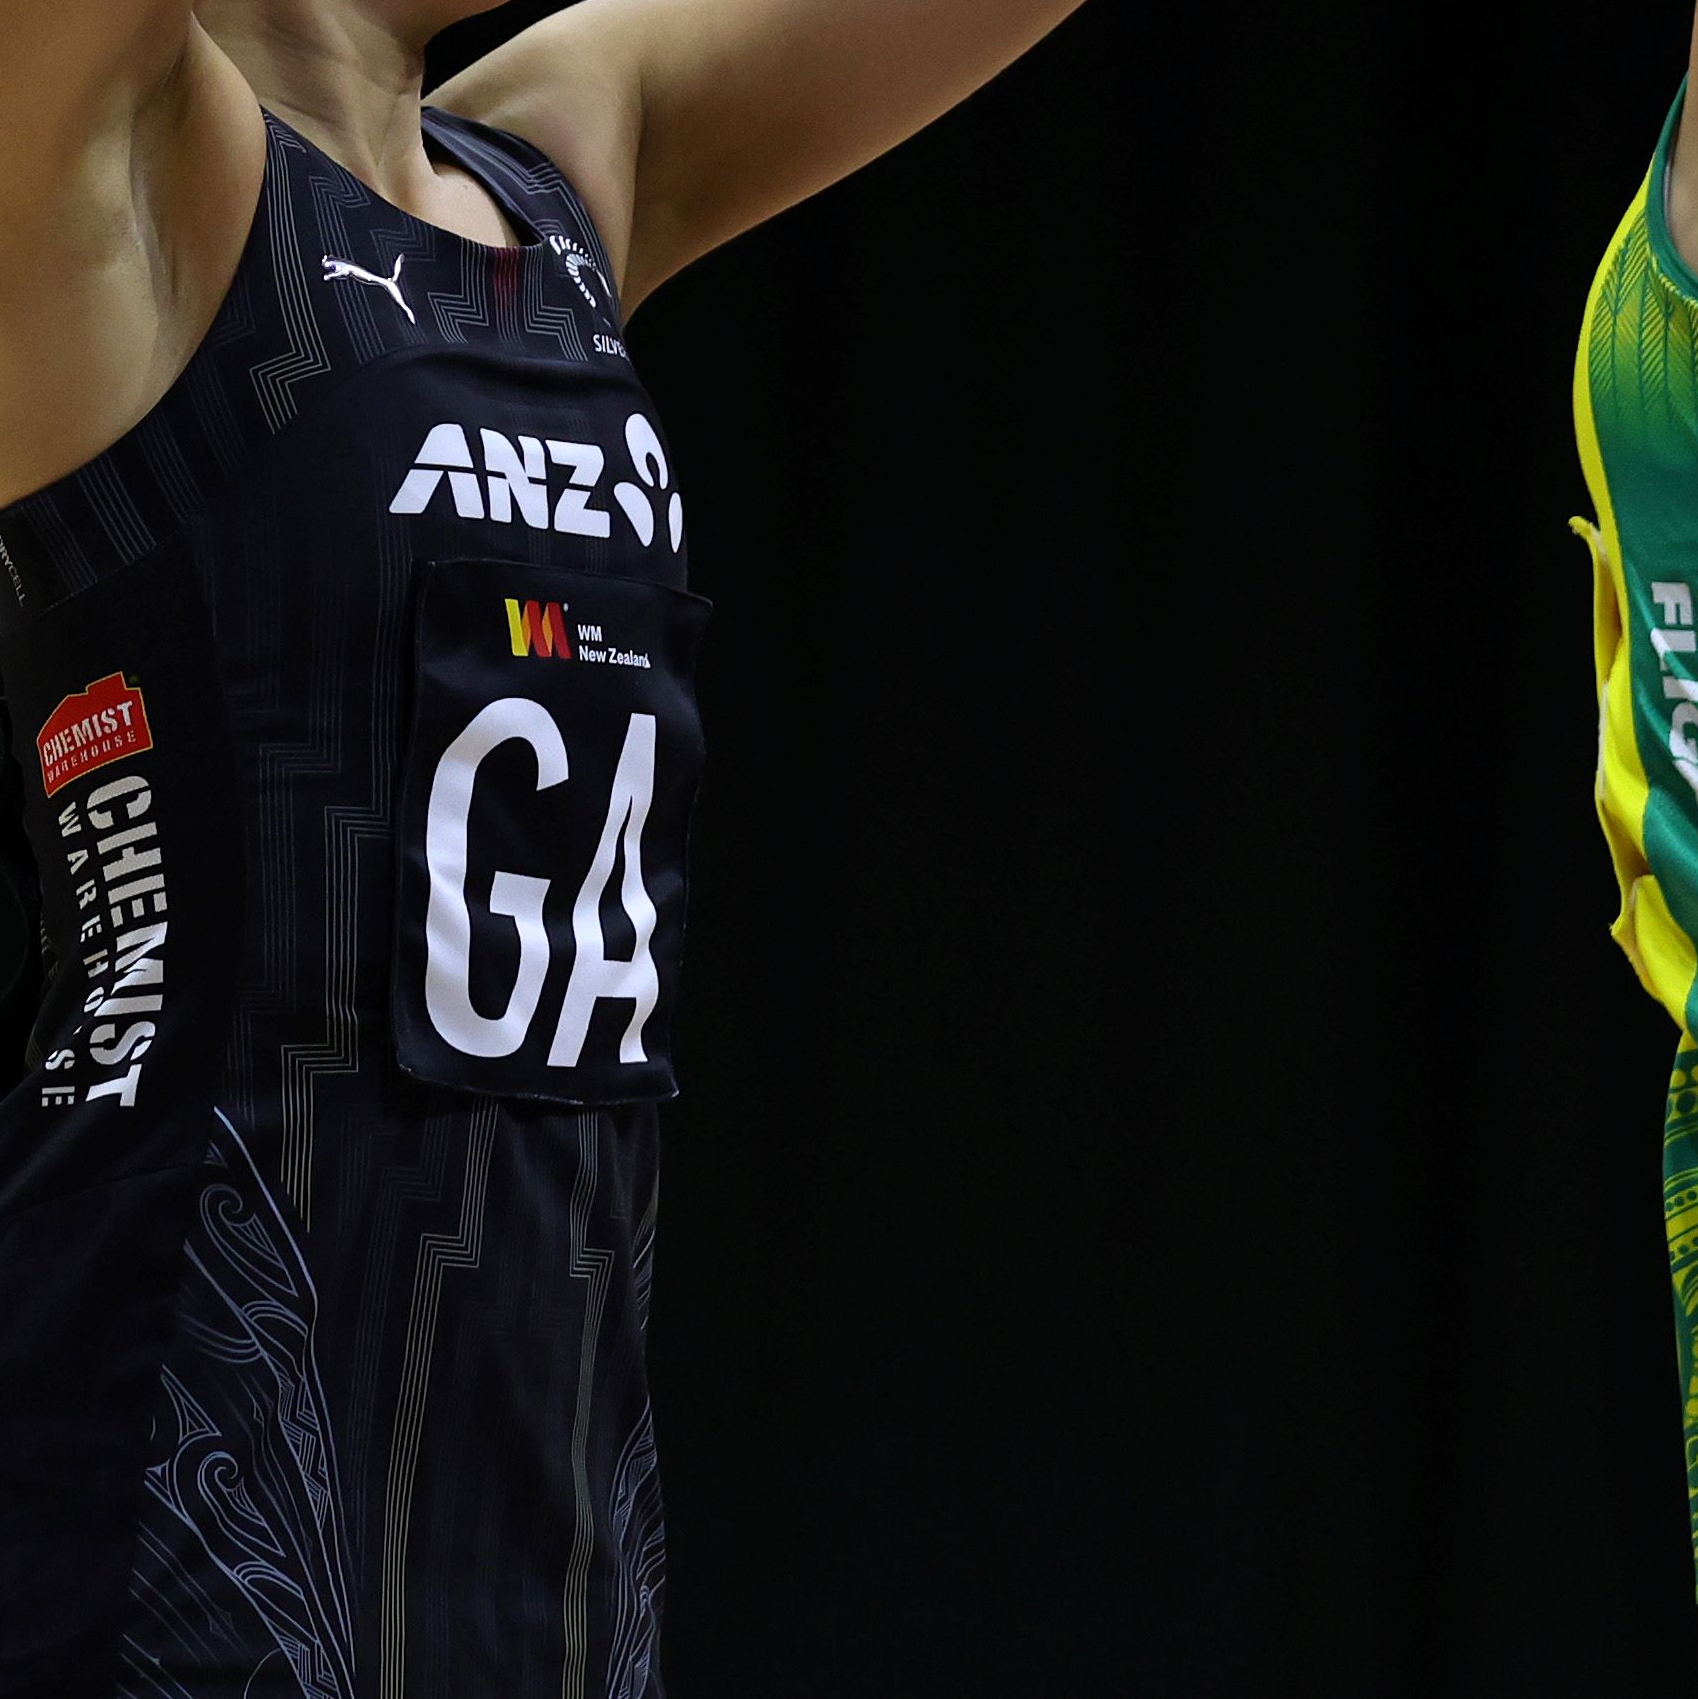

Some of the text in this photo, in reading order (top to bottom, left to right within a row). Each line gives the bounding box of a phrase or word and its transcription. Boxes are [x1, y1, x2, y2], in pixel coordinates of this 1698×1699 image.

[389, 423, 610, 539] ANZ
[577, 623, 603, 643] WM
[578, 644, 606, 663] New
[42, 700, 134, 768] CHEMIST
[46, 729, 137, 784] WAREHOUSE
[425, 696, 660, 1068] GA
[41, 801, 110, 1107] WAREHOSE
[85, 774, 169, 1108] CHEMIST
